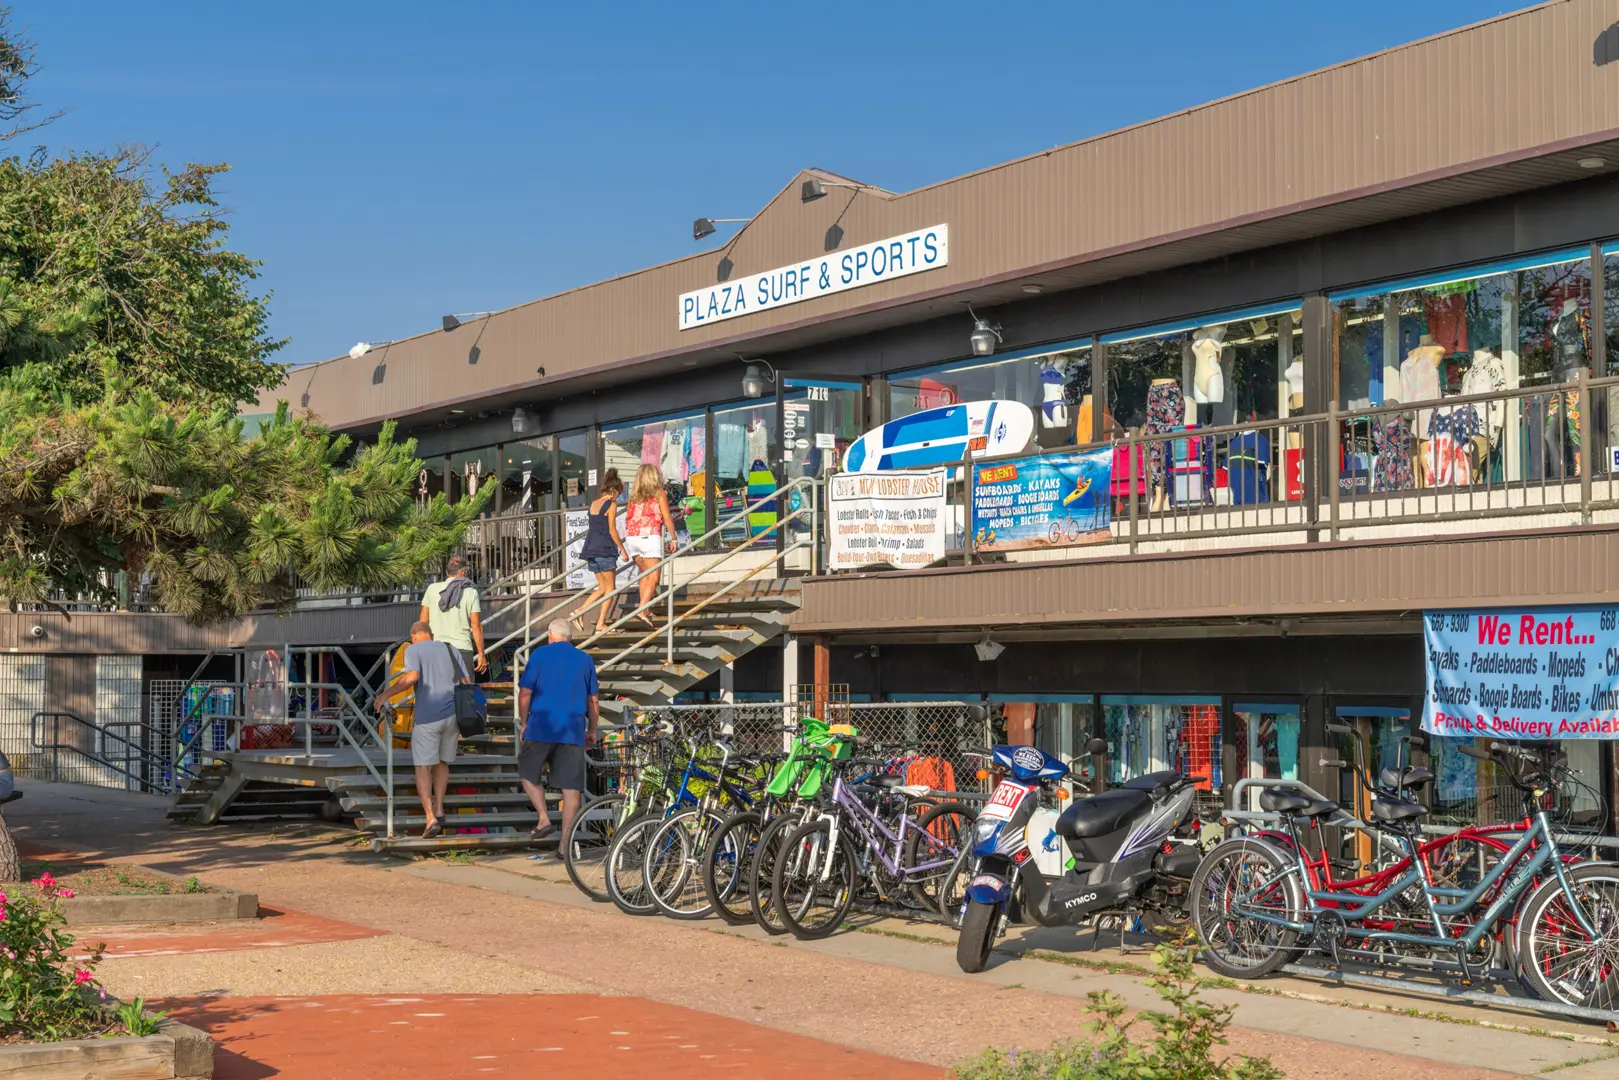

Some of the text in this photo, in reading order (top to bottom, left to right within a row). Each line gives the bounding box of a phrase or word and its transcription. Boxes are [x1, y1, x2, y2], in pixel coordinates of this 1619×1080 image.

[684, 232, 938, 324] PLAZA SURF & SPORTS
[994, 466, 1013, 480] RENT
[877, 478, 909, 495] LOBSTER
[912, 476, 940, 495] HOUSE
[975, 478, 1060, 496] SURFBOARDS KAYAKS
[837, 510, 855, 520] Lobster
[856, 508, 869, 520] Rolls
[872, 508, 884, 519] ish
[903, 509, 917, 520] Fish
[923, 508, 937, 520] Chips
[989, 514, 1048, 528] MOPEDS BICYCLES
[847, 537, 867, 549] Lobster
[880, 537, 901, 550] hrimp
[906, 538, 924, 549] Salads
[1431, 613, 1445, 632] 668
[1450, 614, 1470, 632] 9300
[1477, 615, 1595, 645] We Rent...
[1600, 610, 1616, 631] 668
[1470, 651, 1538, 675] Paddleboards
[1548, 651, 1586, 684] Mopeds
[1479, 682, 1509, 714] Boogie
[1510, 683, 1542, 710] Boards
[1551, 684, 1581, 713] Bikes
[1475, 714, 1487, 730] &
[1491, 715, 1553, 737] Delivery
[992, 784, 1022, 807] RENT
[1065, 892, 1097, 909] KYMCO
